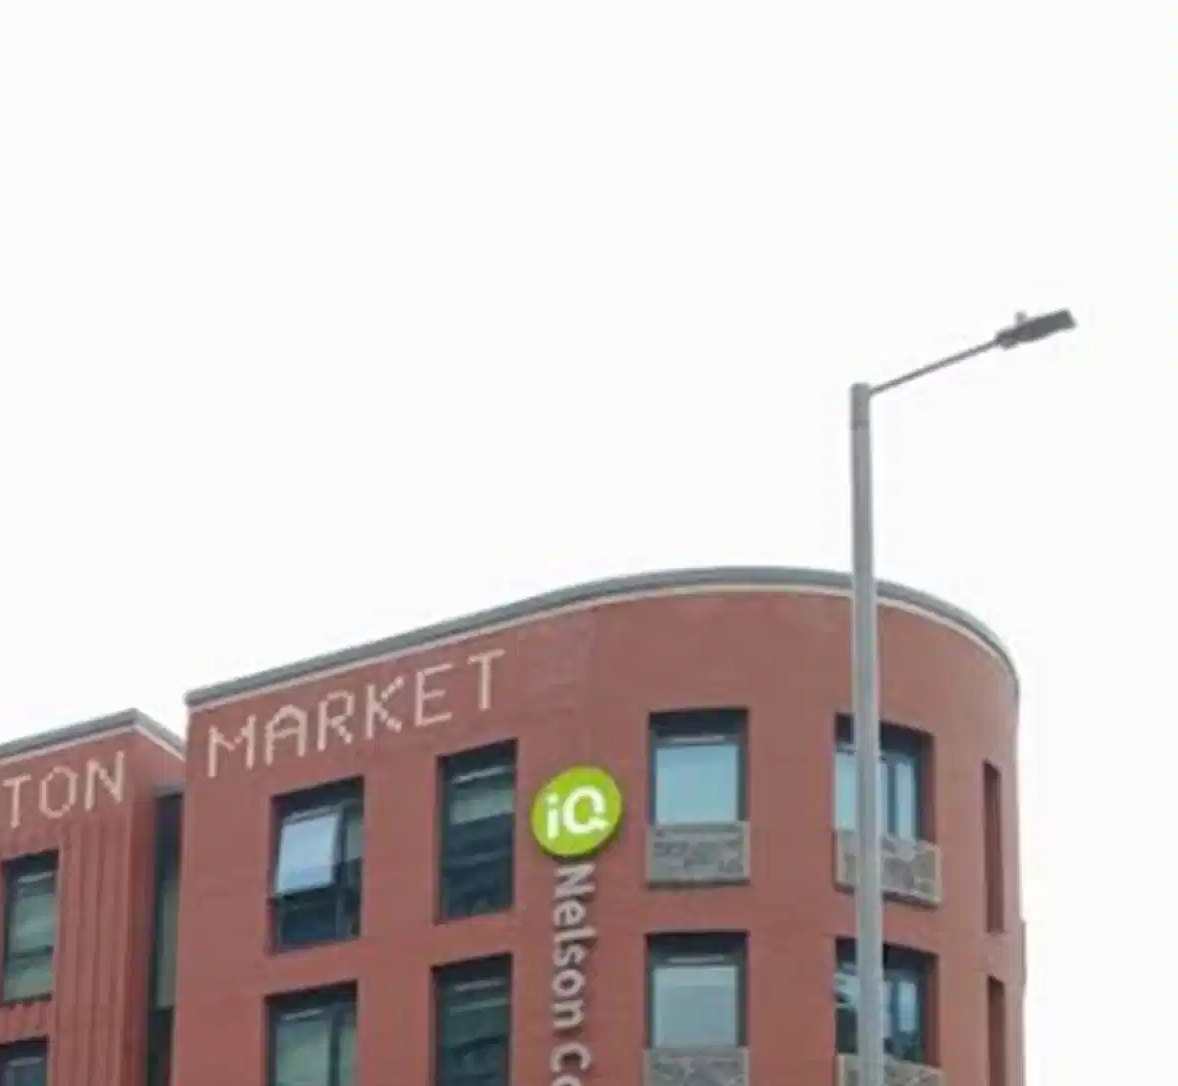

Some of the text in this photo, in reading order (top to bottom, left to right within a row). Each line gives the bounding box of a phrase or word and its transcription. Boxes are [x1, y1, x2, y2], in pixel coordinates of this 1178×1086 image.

[207, 649, 506, 779] MARKET
[545, 785, 610, 839] iQ
[552, 863, 598, 1029] Nelson
